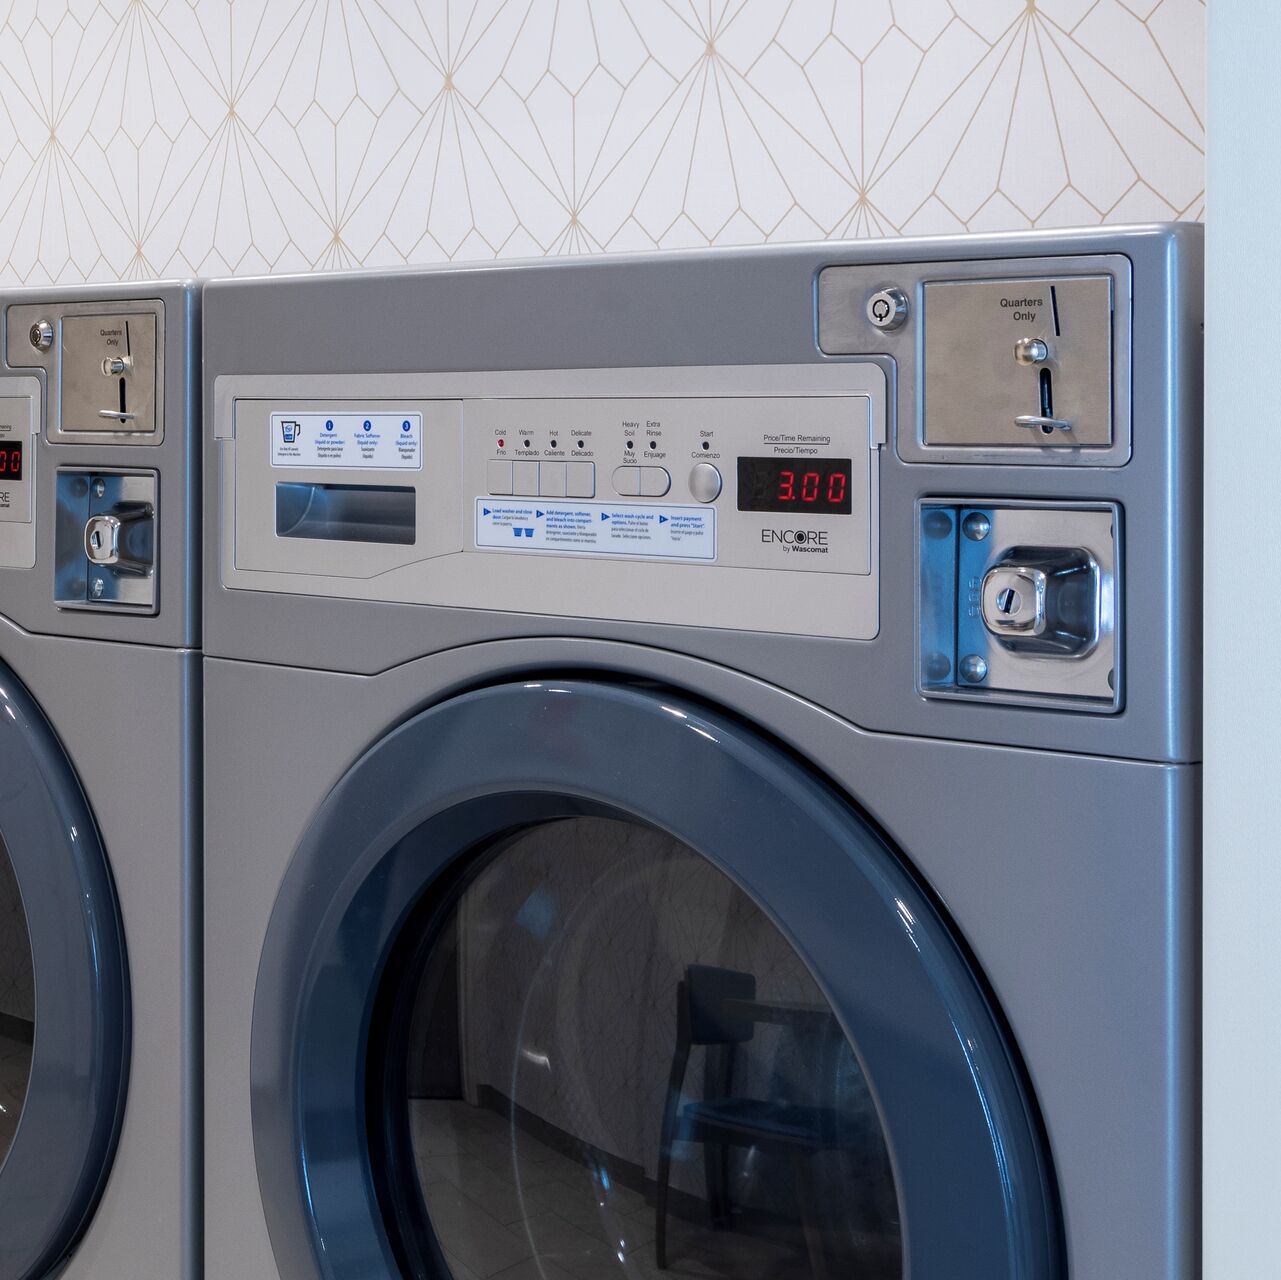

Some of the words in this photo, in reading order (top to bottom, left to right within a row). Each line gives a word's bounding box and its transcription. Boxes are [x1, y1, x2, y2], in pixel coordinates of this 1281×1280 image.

[1000, 298, 1043, 308] Quarters
[1013, 311, 1036, 323] Only
[622, 421, 640, 429] Heavy
[646, 420, 661, 428] Extra
[570, 429, 592, 437] Delicate
[624, 429, 635, 437] Soil
[763, 434, 796, 442] Price/Time
[797, 435, 831, 444] Remaining
[515, 449, 540, 457] Templado
[544, 449, 566, 457] Caliente
[624, 450, 635, 458] Muy
[774, 446, 818, 455] Precio/Tiempo
[643, 451, 667, 459] Enjuage
[691, 451, 721, 459] Comienzo
[778, 471, 846, 503] 3.00
[761, 528, 829, 546] ENCORE
[782, 545, 791, 554] by
[791, 545, 829, 554] Wascomat
